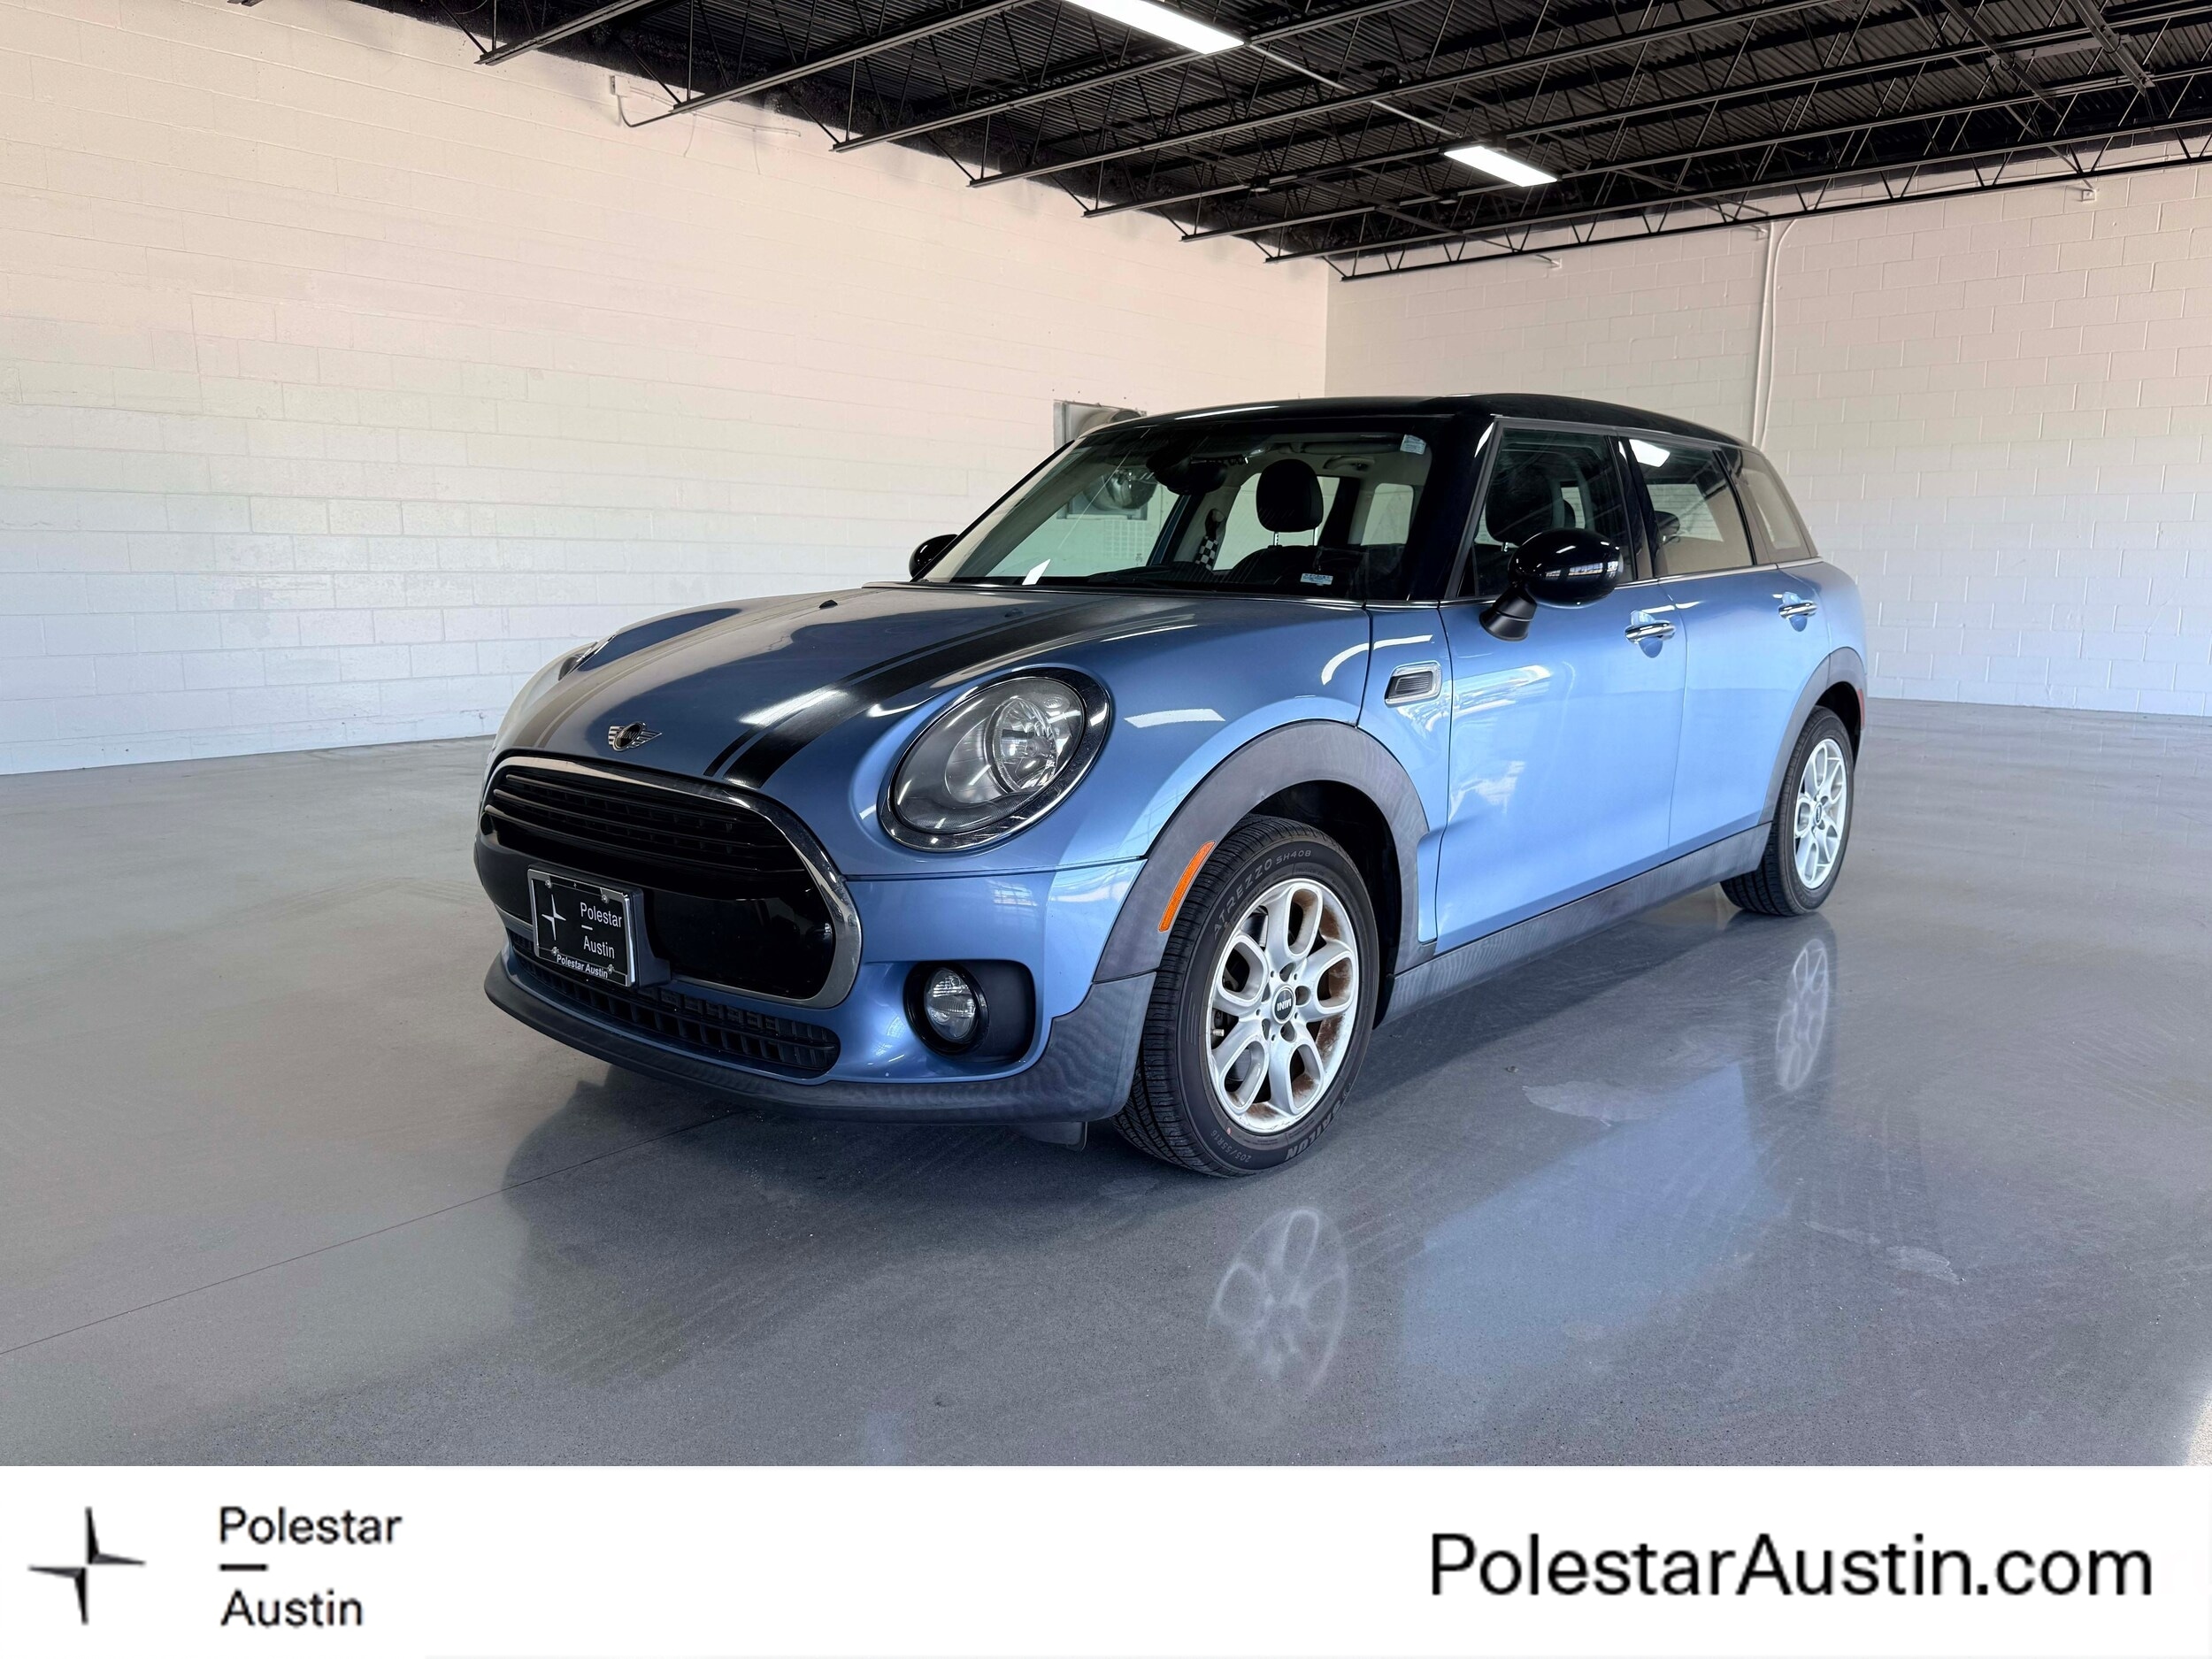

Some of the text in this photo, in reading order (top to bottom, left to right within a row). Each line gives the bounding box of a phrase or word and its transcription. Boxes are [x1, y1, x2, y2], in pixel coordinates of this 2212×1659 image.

[1215, 850, 1311, 941] ATREZZO SH408
[580, 902, 623, 928] Polestar
[583, 935, 615, 959] Austin
[557, 954, 609, 979] Polestar Austin
[1277, 998, 1292, 1011] MINI
[1285, 1100, 1341, 1161] SAILUN
[1210, 1130, 1252, 1163] 205/55R16
